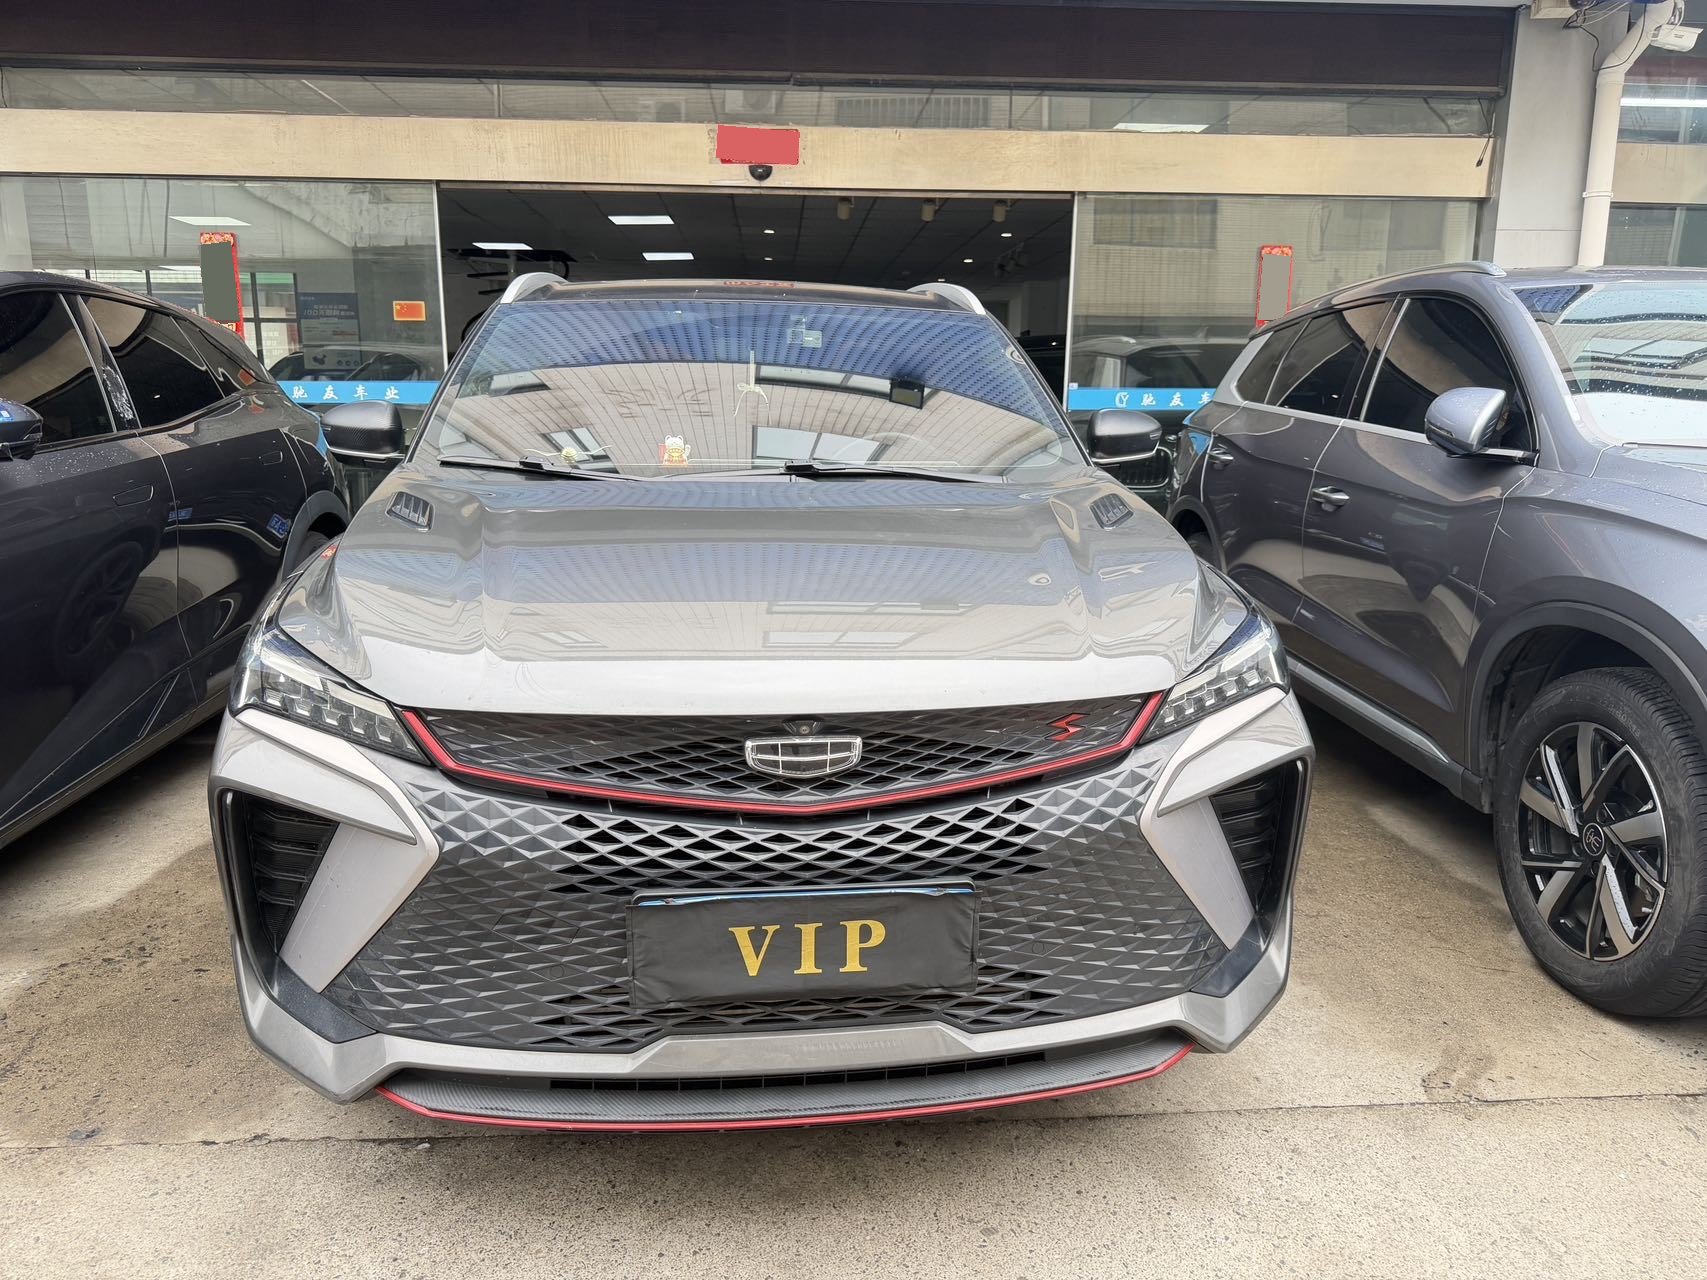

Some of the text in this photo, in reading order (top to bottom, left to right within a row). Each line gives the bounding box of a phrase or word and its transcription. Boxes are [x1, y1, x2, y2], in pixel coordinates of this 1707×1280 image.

[291, 384, 401, 400] 驰友车业
[728, 919, 886, 977] VIP
